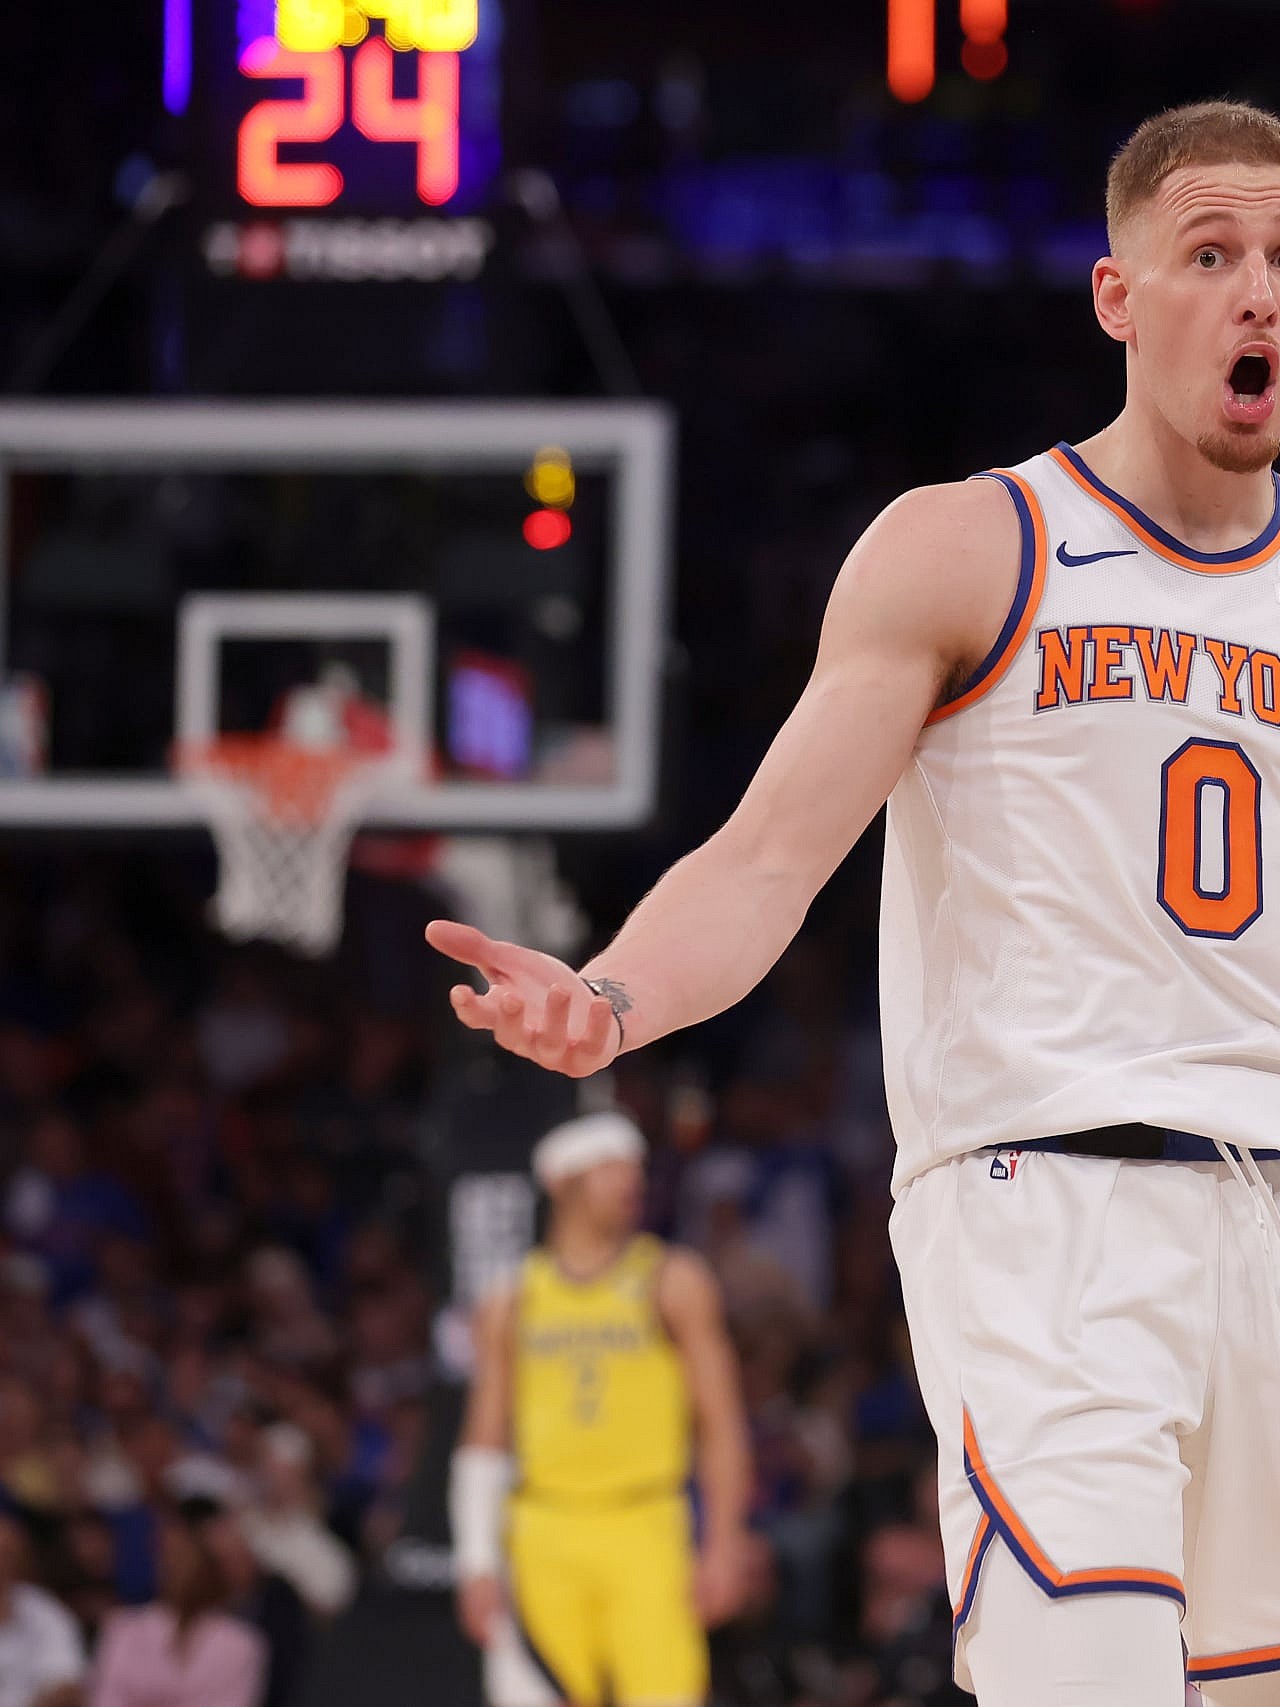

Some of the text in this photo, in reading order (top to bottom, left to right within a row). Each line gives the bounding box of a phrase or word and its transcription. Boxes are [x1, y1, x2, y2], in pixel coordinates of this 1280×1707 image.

[237, 36, 461, 207] 24
[1034, 624, 1198, 713] NEW
[1157, 736, 1264, 942] 0
[991, 1167, 1006, 1178] NBA
